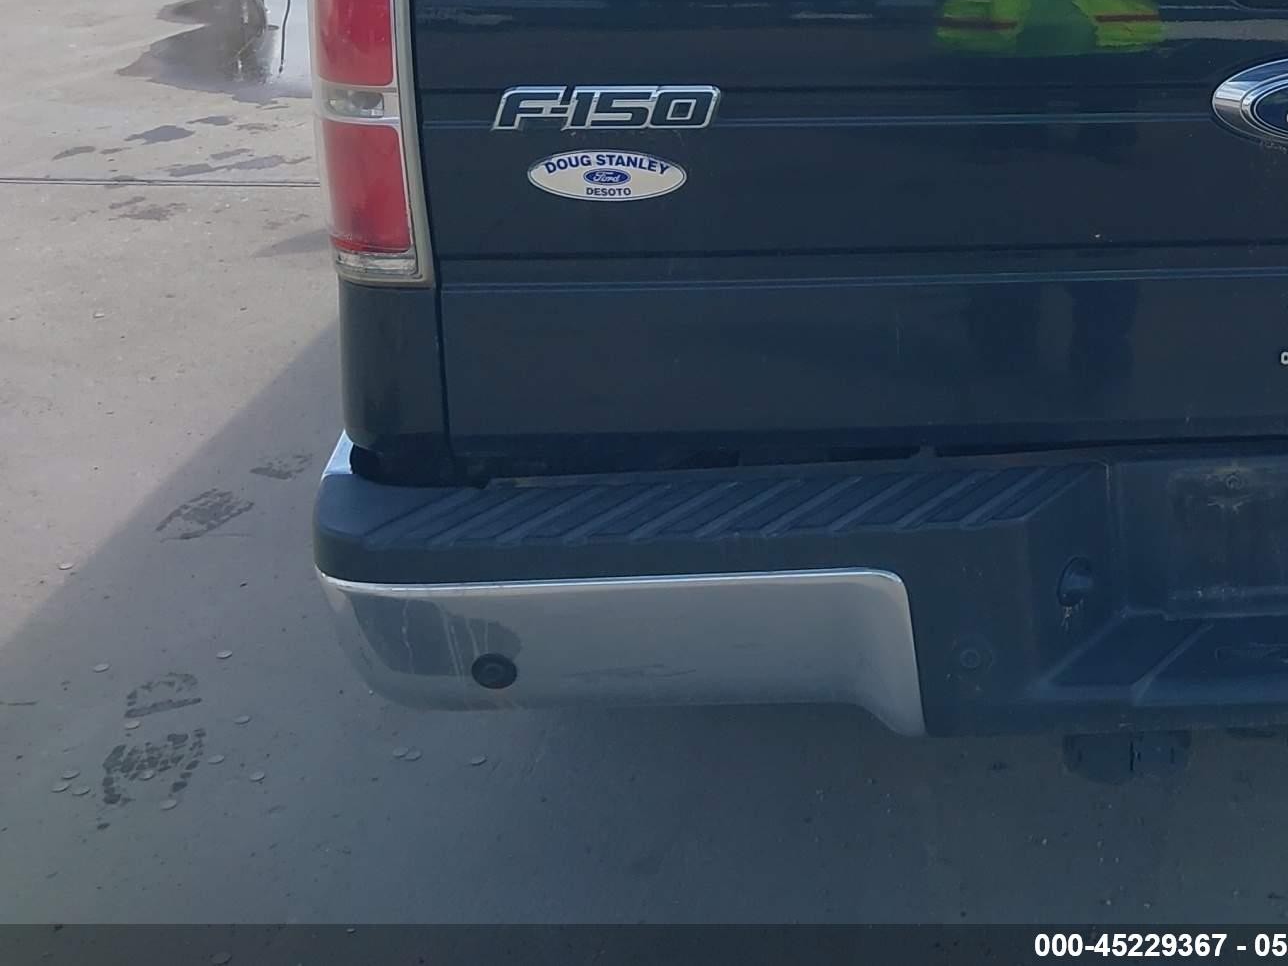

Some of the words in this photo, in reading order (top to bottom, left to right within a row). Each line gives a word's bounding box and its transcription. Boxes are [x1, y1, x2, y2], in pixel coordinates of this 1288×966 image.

[491, 85, 720, 131] F-150
[544, 155, 592, 174] DOUG
[596, 154, 669, 175] STANLEY
[592, 171, 621, 182] Ford
[586, 187, 632, 196] DESOTO
